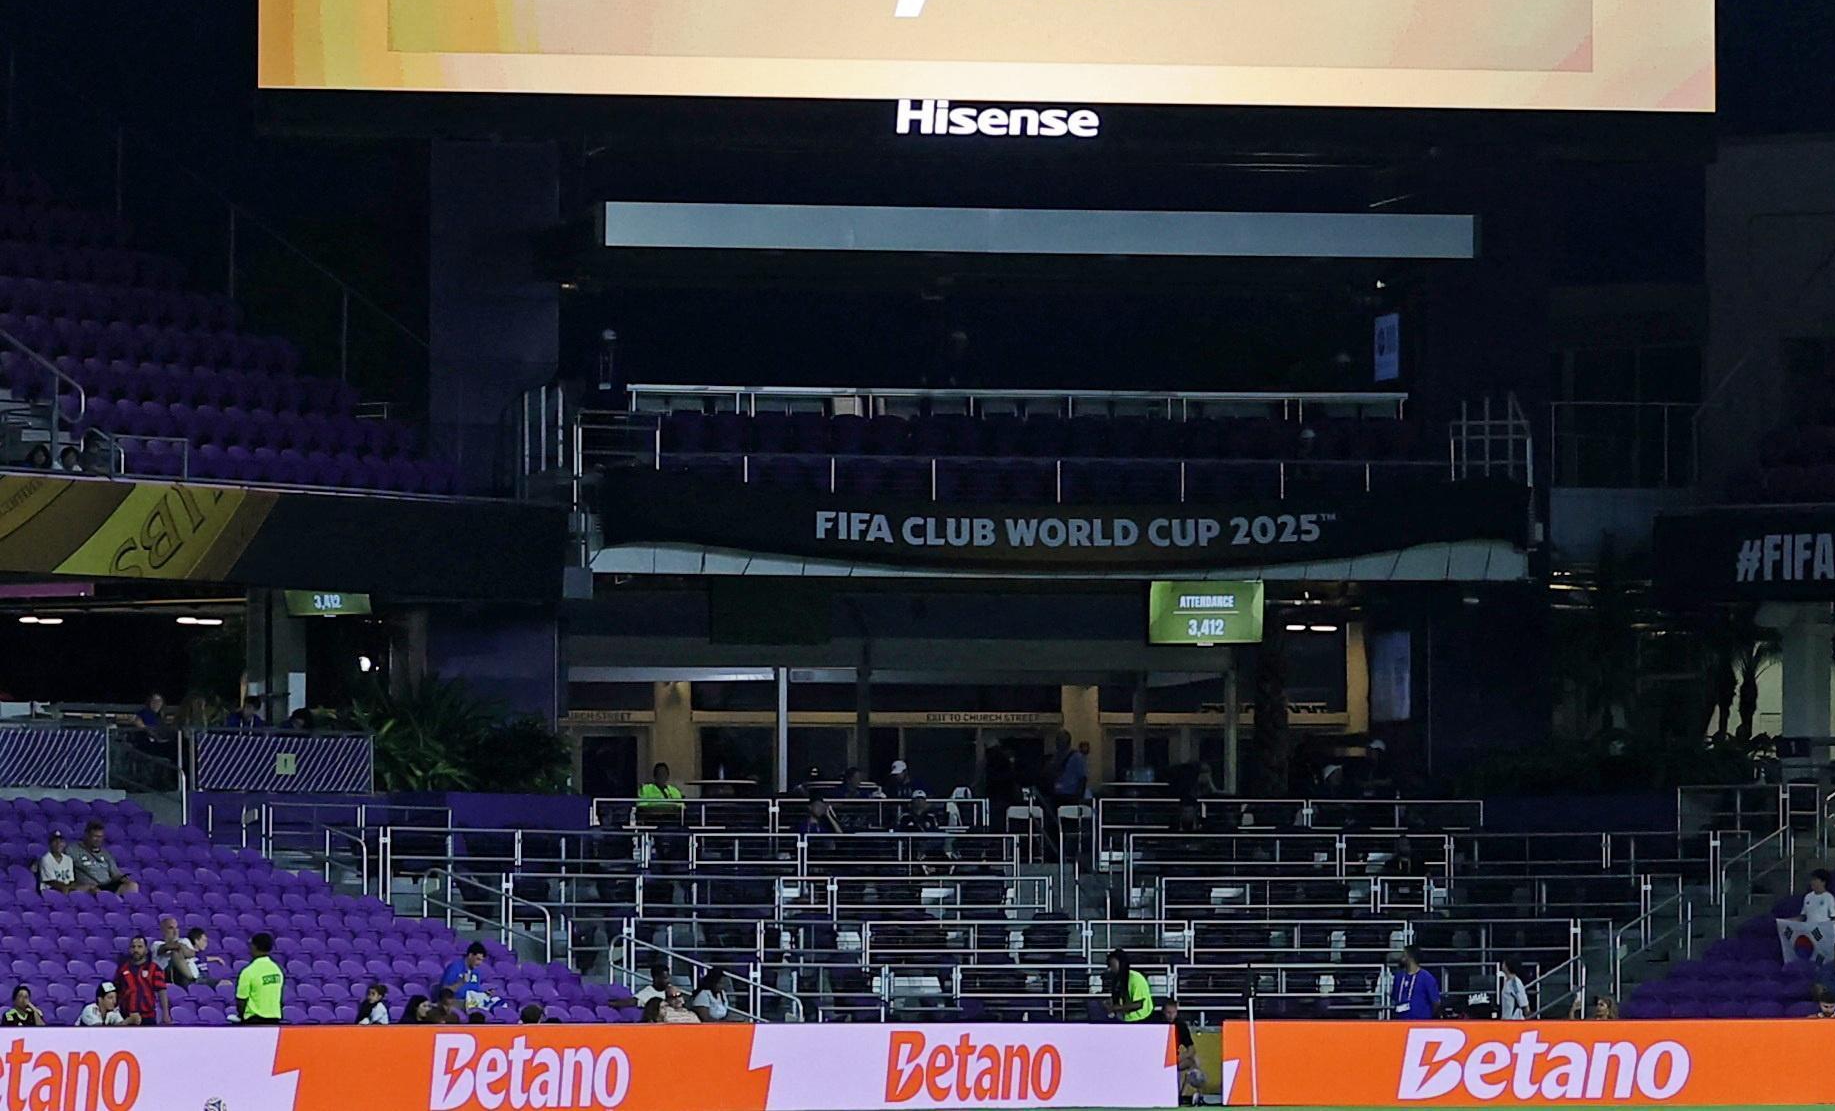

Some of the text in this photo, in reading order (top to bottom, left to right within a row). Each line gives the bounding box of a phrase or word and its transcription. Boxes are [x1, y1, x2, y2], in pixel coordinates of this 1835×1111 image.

[895, 99, 1100, 138] Hisense
[815, 510, 893, 543] FIFA
[901, 515, 997, 547] CLUB
[1004, 517, 1140, 548] WORLD
[1147, 517, 1221, 548] CUP
[1179, 595, 1235, 608] ATTENDANCE
[1188, 618, 1225, 638] 3,412
[0, 1038, 141, 1111] tano
[429, 1032, 630, 1109] Betano
[886, 1030, 1062, 1102] Betano
[1396, 1026, 1690, 1100] Betano
